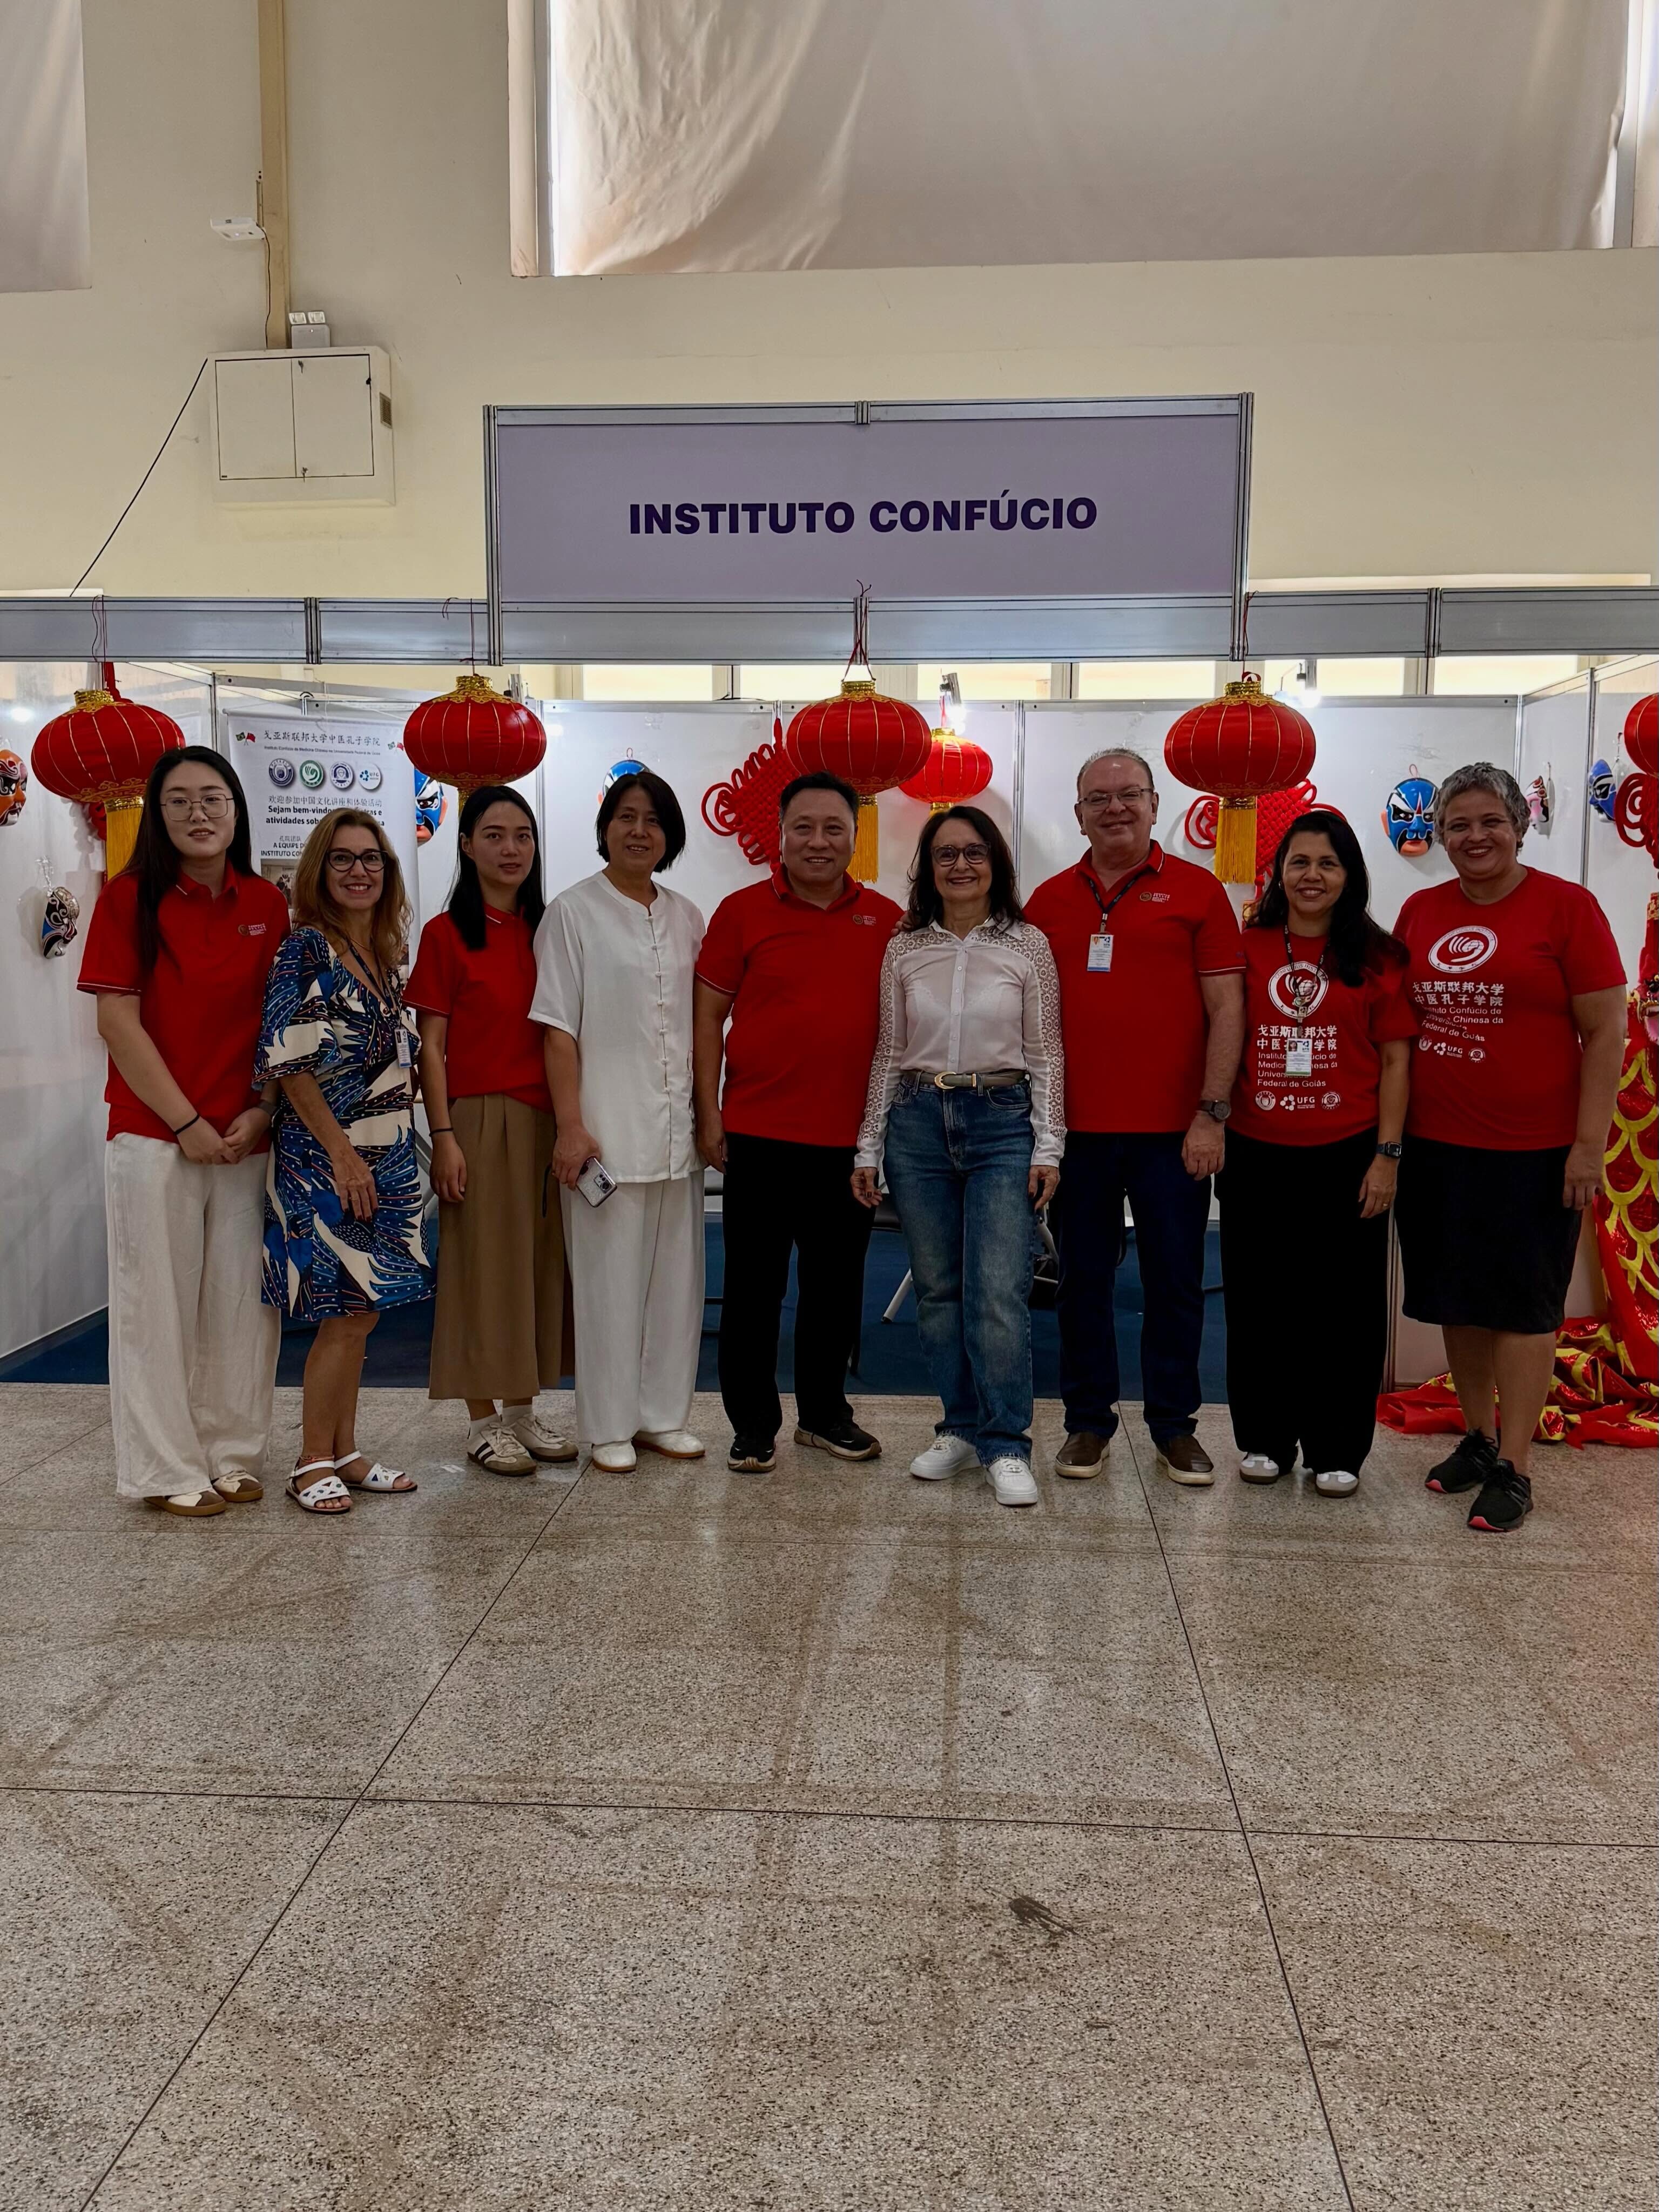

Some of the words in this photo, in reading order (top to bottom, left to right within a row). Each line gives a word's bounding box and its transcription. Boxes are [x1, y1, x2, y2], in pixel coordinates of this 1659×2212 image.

[630, 502, 855, 535] INSTITUTO
[869, 490, 1097, 532] CONFÚCIO
[268, 806, 292, 814] Sejam
[293, 806, 332, 814] bem-vindo
[1412, 981, 1505, 995] 戈亚斯联邦大学
[1414, 994, 1503, 1007] 中医孔子学院
[1449, 1007, 1487, 1015] Confúcio
[1453, 1015, 1489, 1024] Chinesa
[1421, 1020, 1448, 1033] Federal
[1257, 1037, 1337, 1051] 中医学院
[1447, 1046, 1463, 1054] UFG
